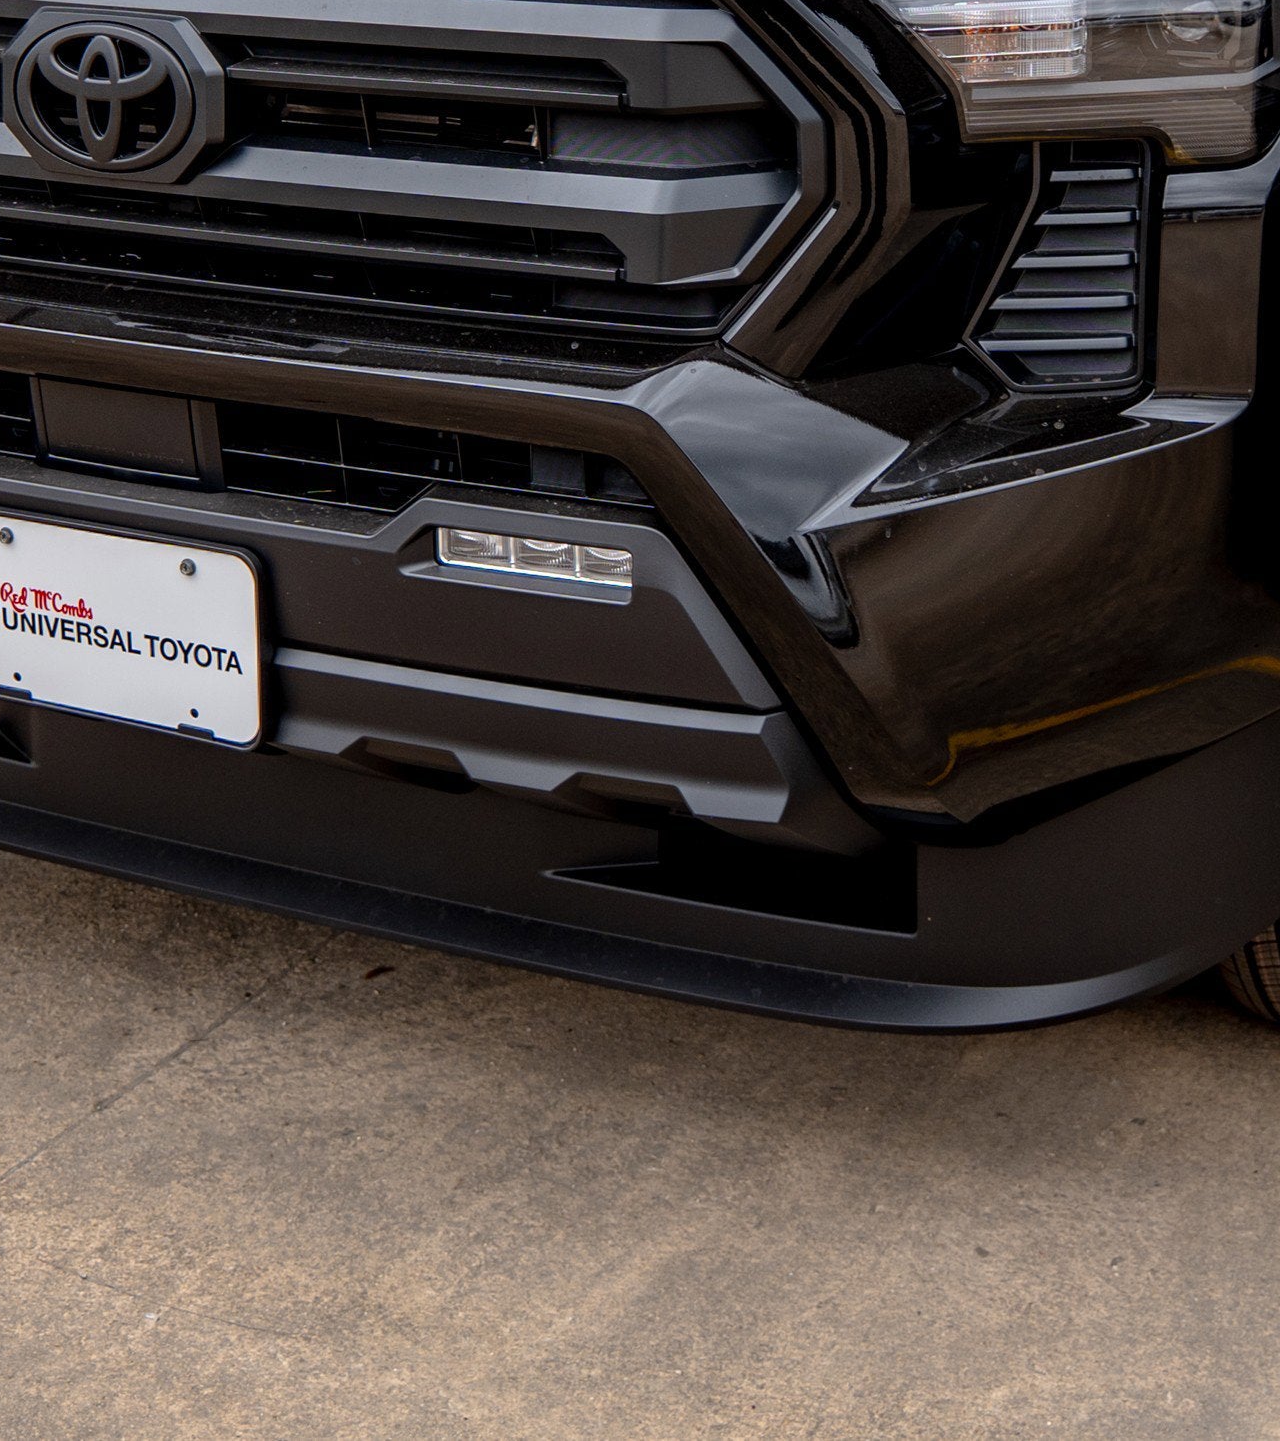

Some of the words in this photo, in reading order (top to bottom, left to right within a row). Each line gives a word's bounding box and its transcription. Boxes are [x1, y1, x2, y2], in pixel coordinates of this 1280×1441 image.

[0, 582, 28, 608] Red
[2, 607, 141, 655] UNIVERSAL
[144, 634, 243, 675] TOYOTA
